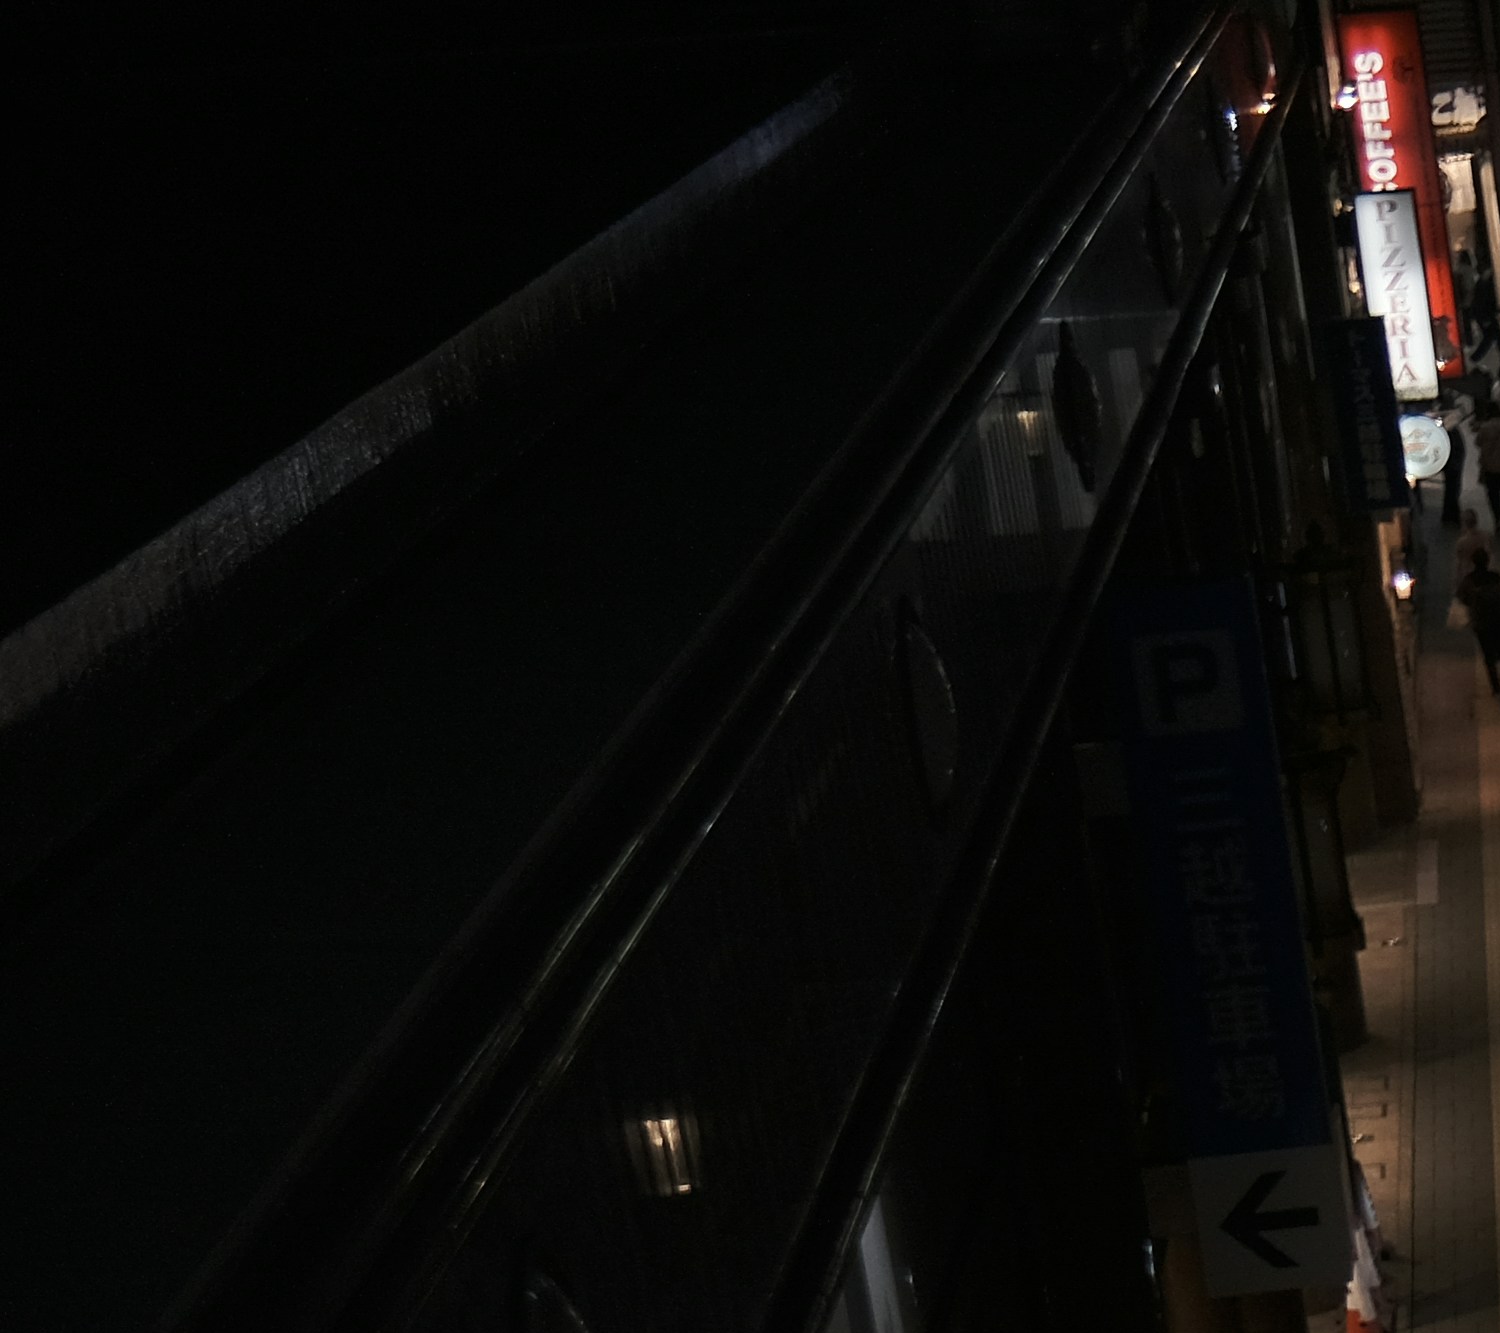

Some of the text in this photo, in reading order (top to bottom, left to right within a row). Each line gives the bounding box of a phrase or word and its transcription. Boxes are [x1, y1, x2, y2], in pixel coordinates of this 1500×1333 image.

[1354, 50, 1399, 193] OFFEE'S
[1375, 198, 1418, 384] PIZZERIA
[1152, 641, 1219, 723] P
[1167, 764, 1288, 1124] 三越駐車場
